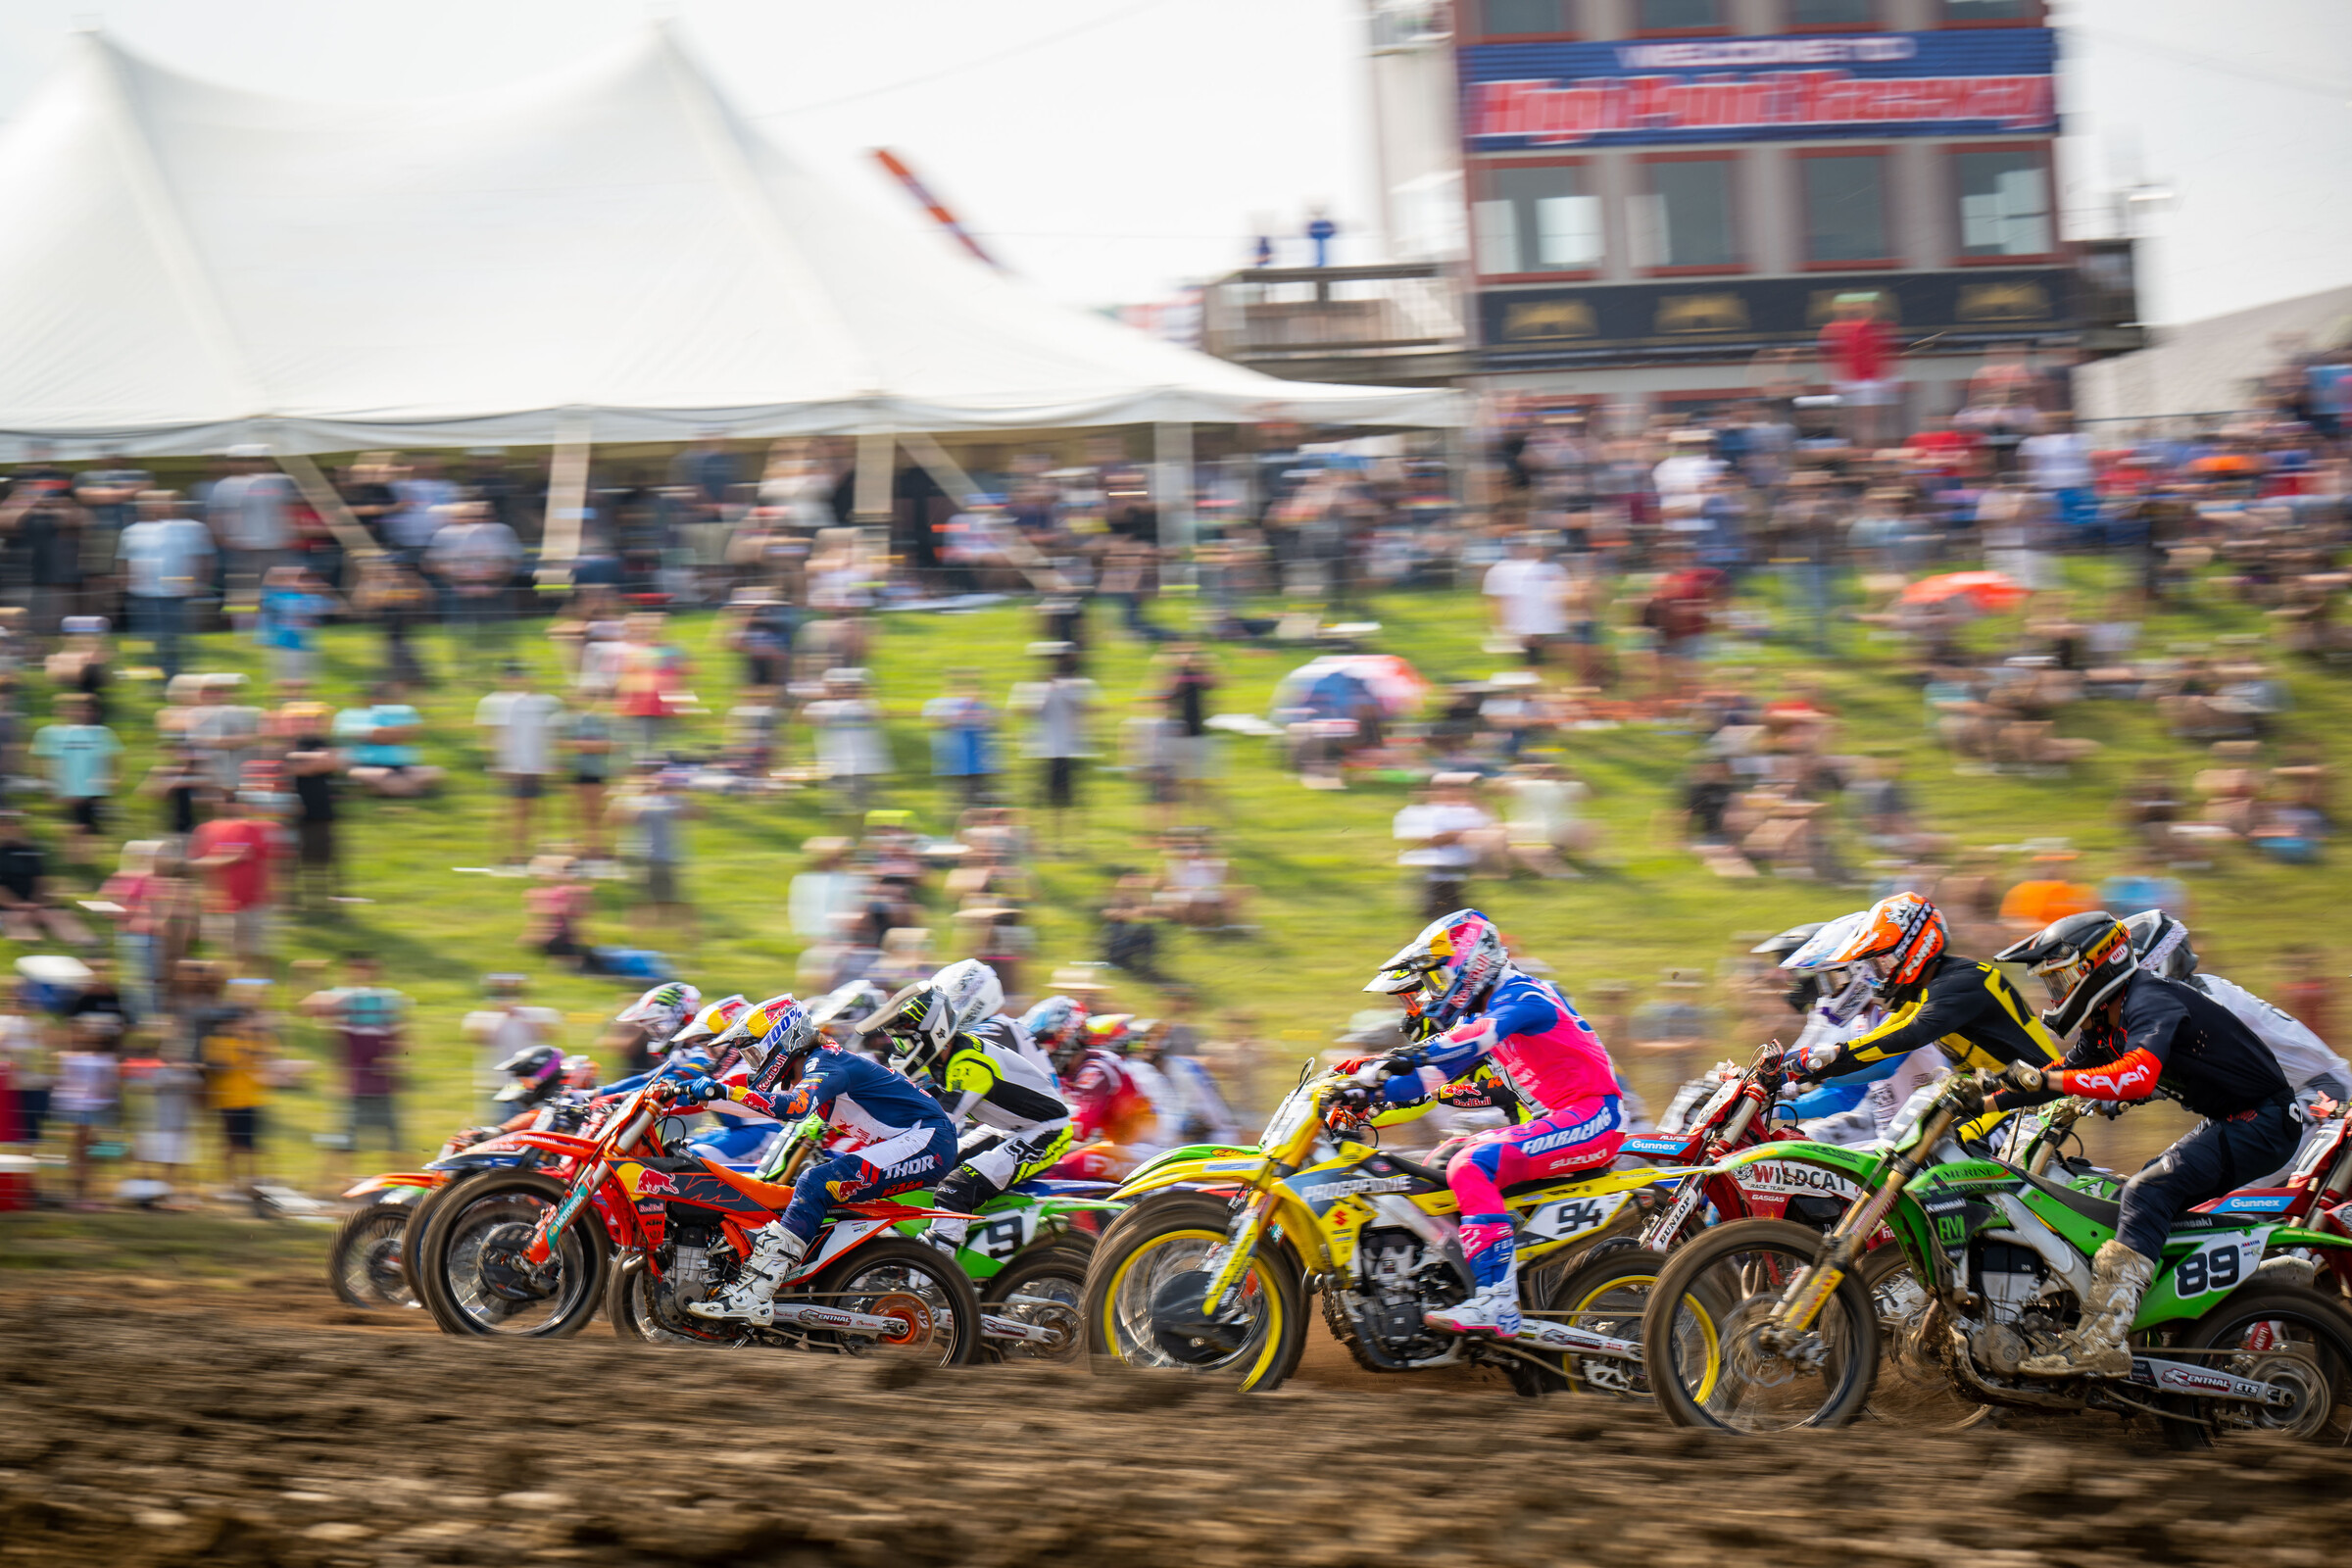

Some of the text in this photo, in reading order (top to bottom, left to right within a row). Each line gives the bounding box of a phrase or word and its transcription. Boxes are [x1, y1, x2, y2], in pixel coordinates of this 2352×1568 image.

[2111, 947, 2127, 961] BELL
[762, 1006, 803, 1051] 100%
[756, 1053, 789, 1093] Red Bull
[1453, 1097, 1492, 1107] Red Bull
[1632, 1140, 1677, 1151] Gunnex
[883, 1154, 936, 1180] THOR
[1549, 1149, 1607, 1170] SUZUKI
[1752, 1163, 1846, 1191] WILDCAT
[937, 1186, 957, 1195] pod
[1751, 1194, 1785, 1202] GASGAS
[556, 1193, 586, 1229] MOTOREX
[639, 1202, 664, 1213] Red Bull
[2230, 1198, 2280, 1207] Gunnex
[1556, 1199, 1603, 1236] 94
[1658, 1197, 1690, 1246] DUNLOP
[987, 1215, 1023, 1258] 9
[2176, 1245, 2240, 1297] 89
[2235, 1382, 2259, 1394] ETS
